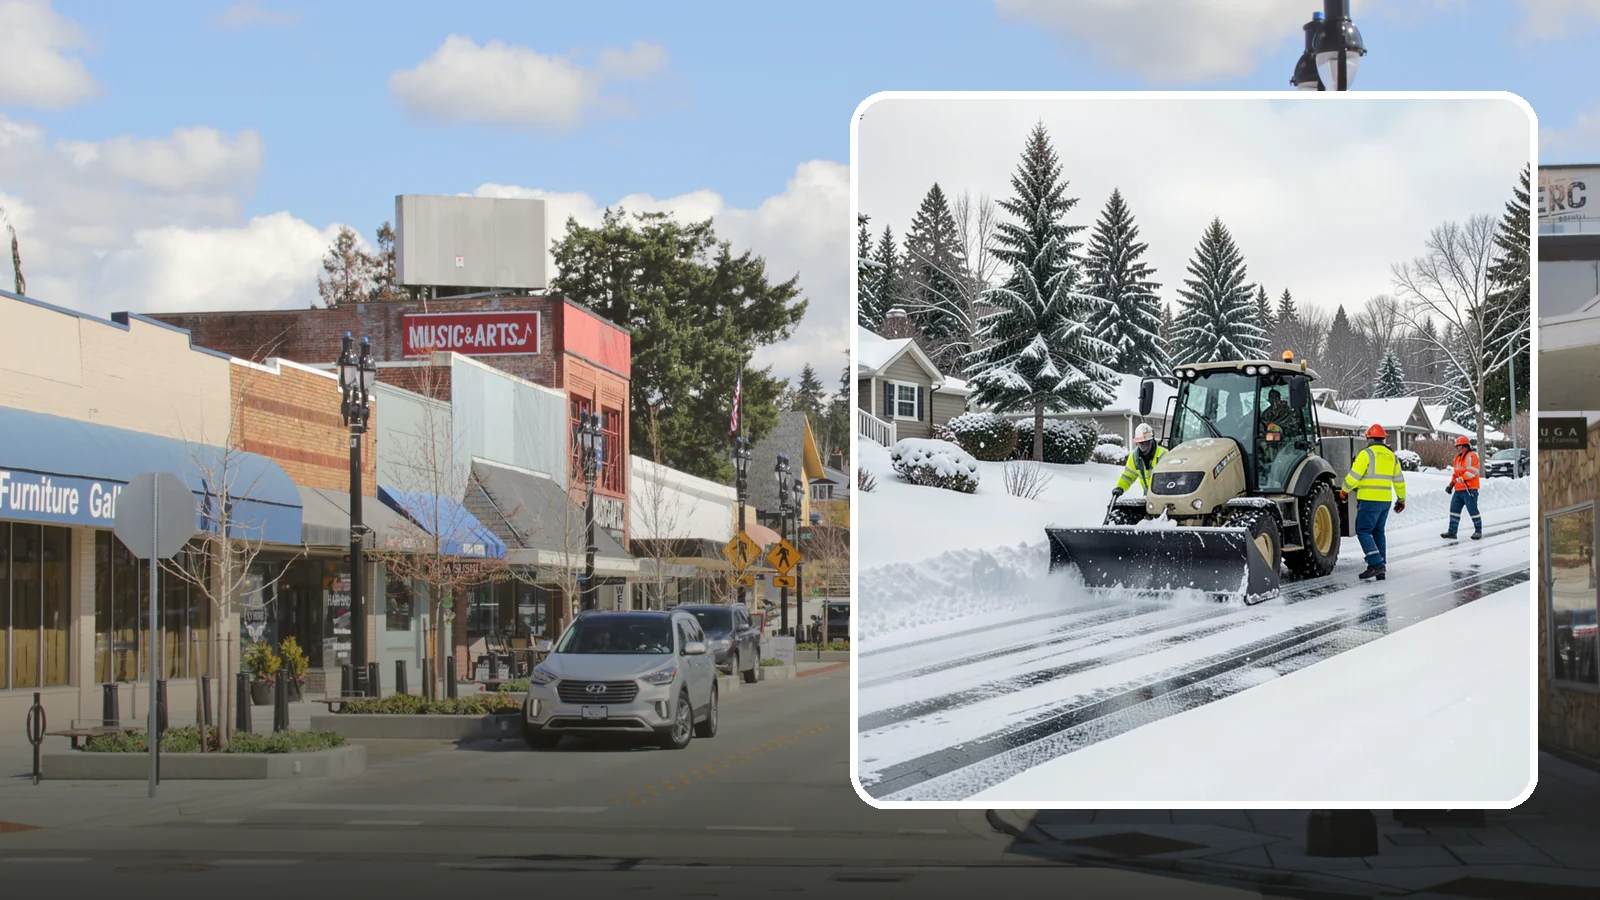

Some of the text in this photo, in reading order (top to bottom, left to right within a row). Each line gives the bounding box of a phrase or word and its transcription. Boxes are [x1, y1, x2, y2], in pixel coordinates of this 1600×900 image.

[409, 323, 519, 348] MUSIC&ARTS
[1540, 427, 1578, 436] UGA
[0, 472, 121, 519] Furniture Gal
